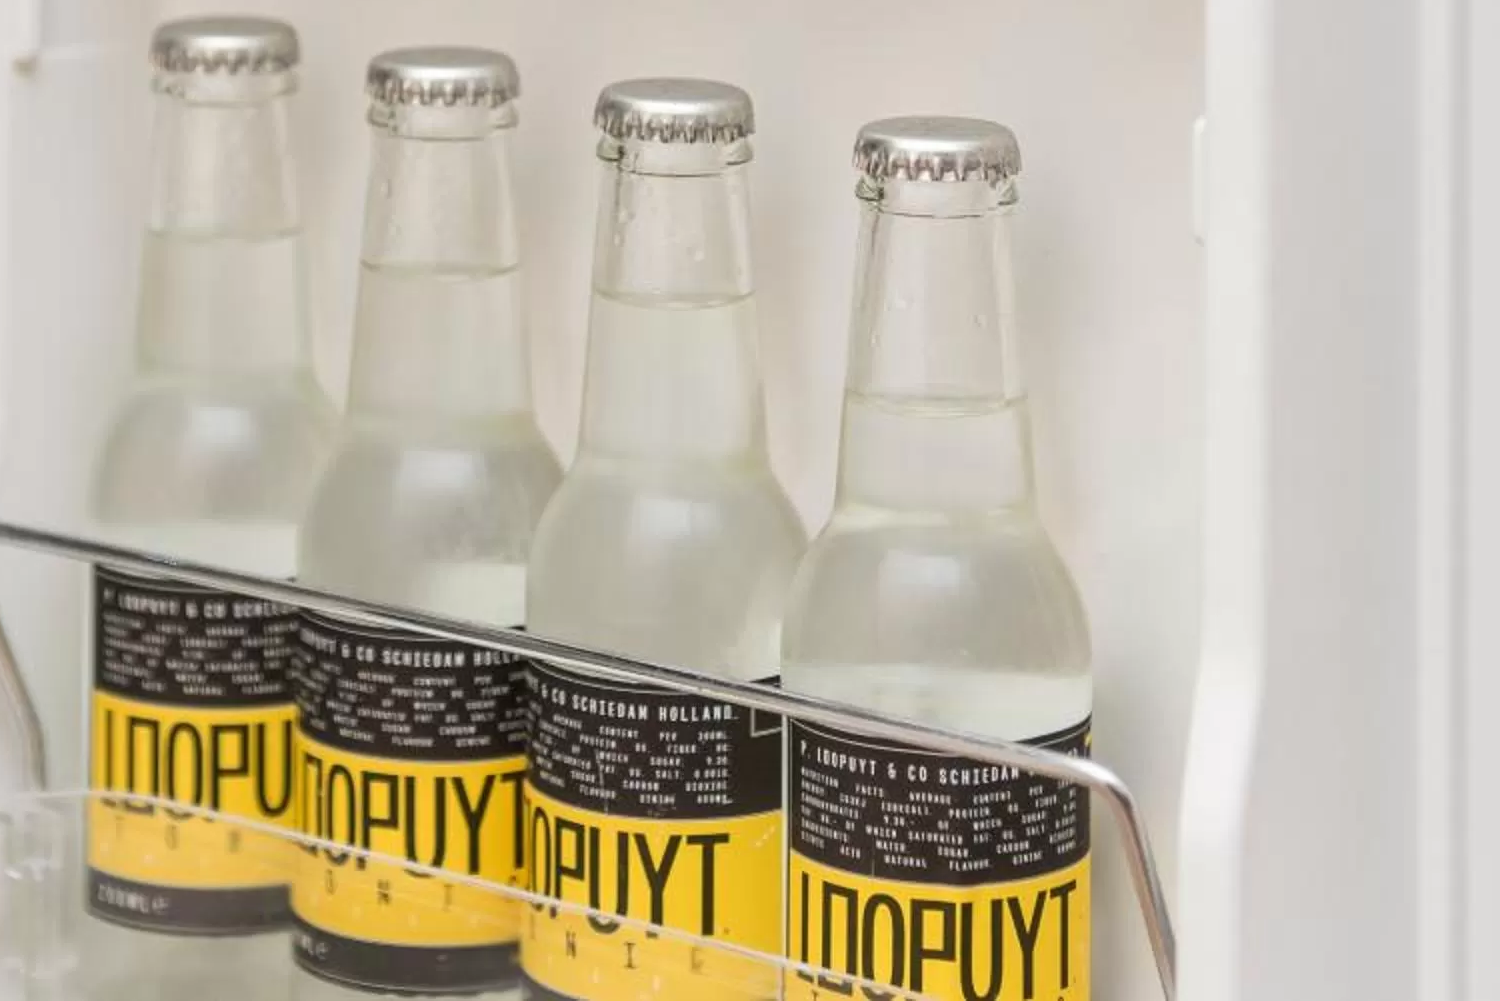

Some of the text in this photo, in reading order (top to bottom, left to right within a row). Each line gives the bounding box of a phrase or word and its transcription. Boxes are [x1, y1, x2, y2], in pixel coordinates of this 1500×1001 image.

[382, 649, 464, 668] SCHIEDAM
[572, 694, 648, 721] SCHIEDAM
[817, 746, 877, 776] LOOPUYT
[907, 764, 928, 782] CO
[939, 766, 1019, 785] SCHIEDAM
